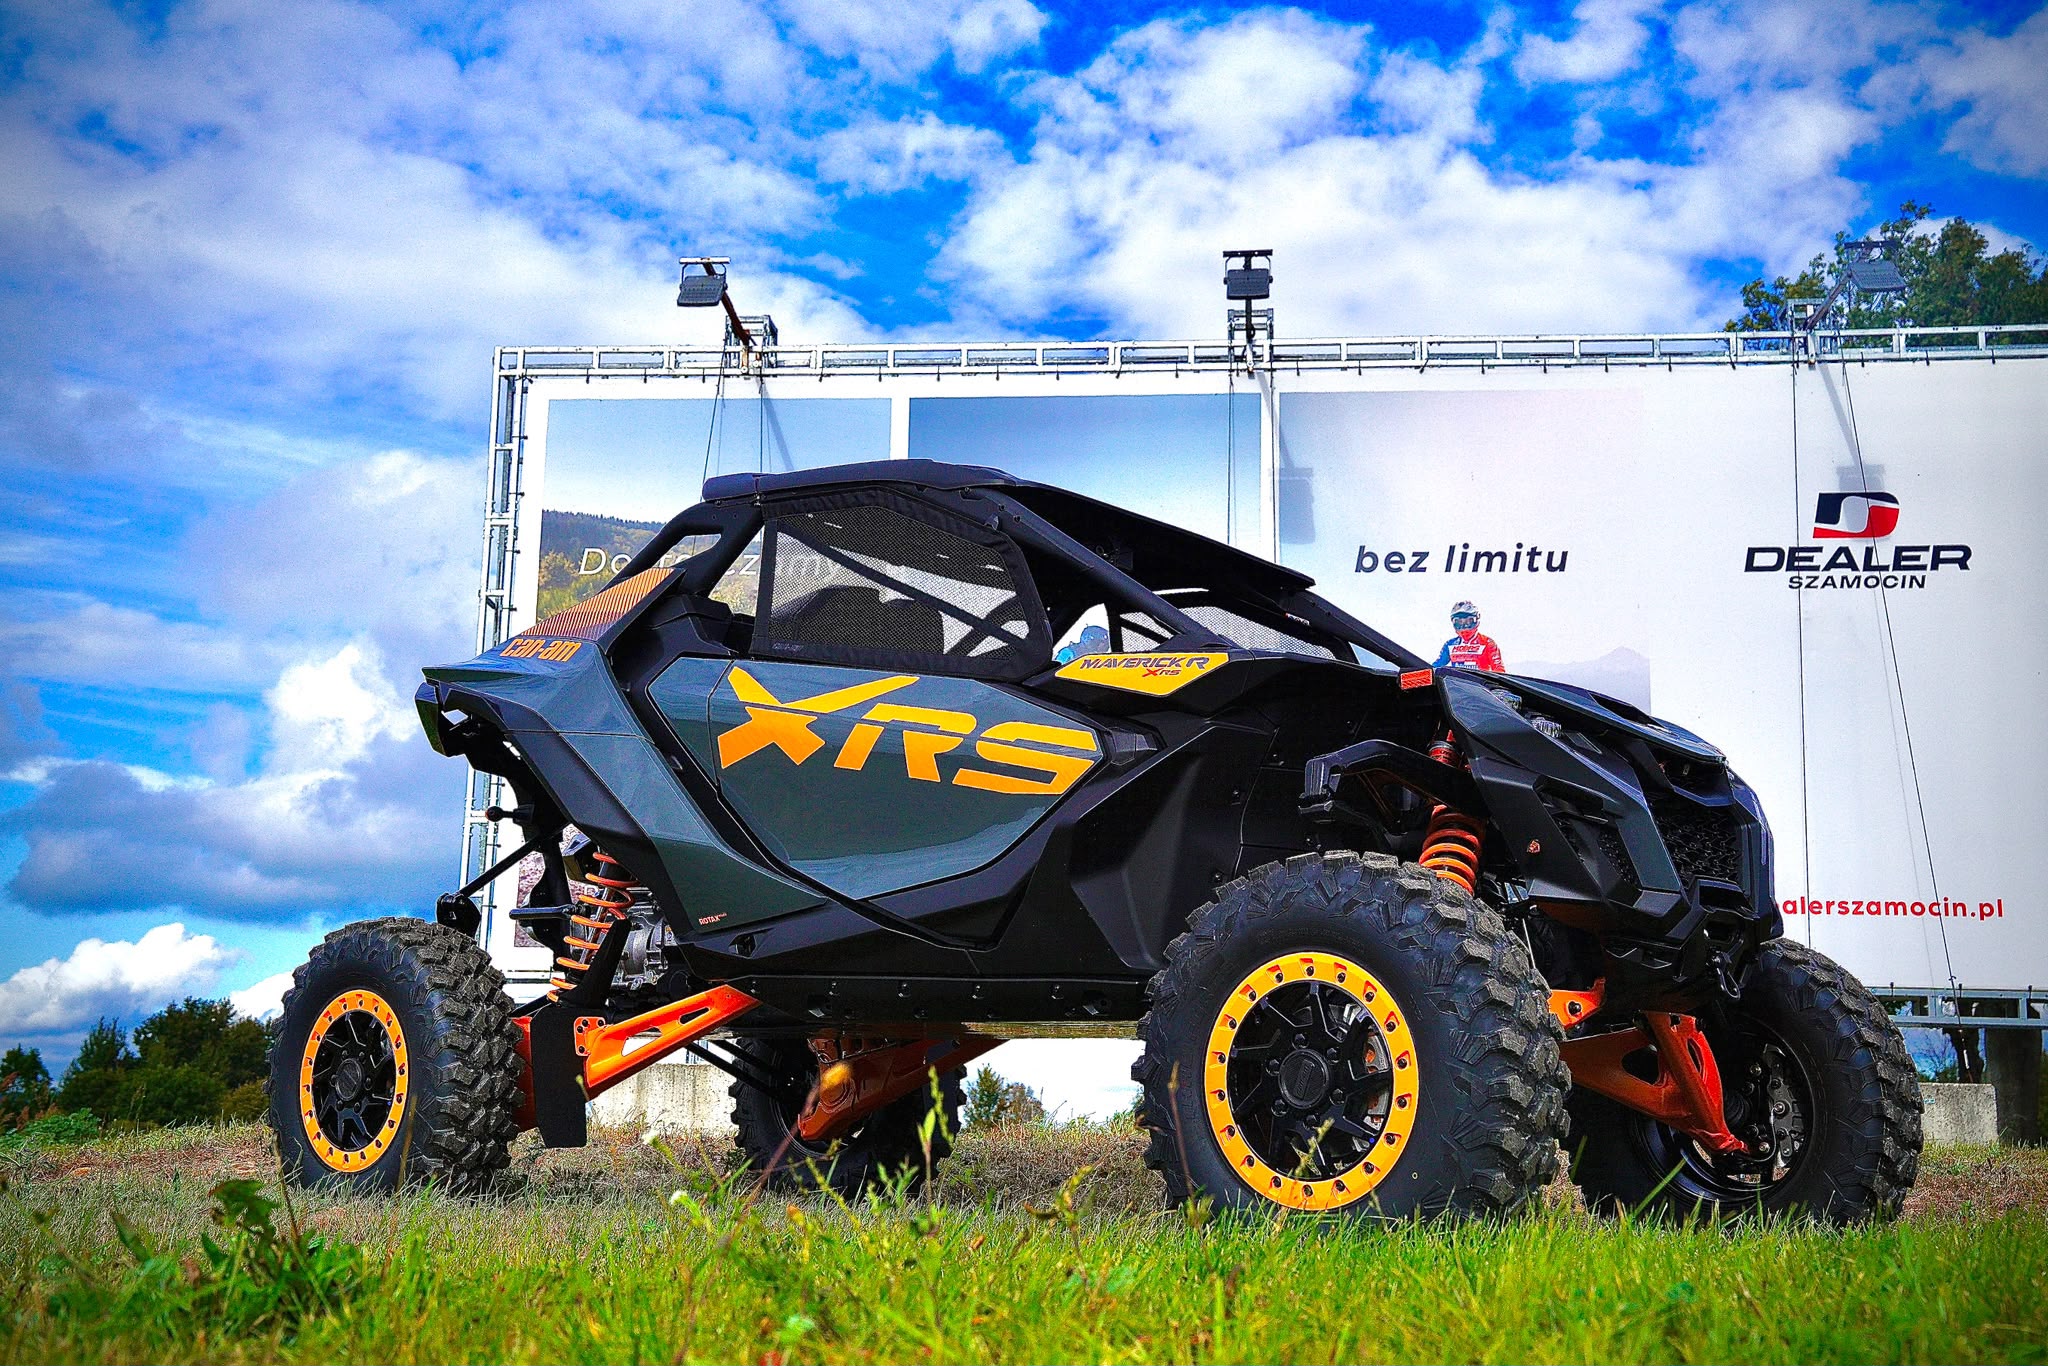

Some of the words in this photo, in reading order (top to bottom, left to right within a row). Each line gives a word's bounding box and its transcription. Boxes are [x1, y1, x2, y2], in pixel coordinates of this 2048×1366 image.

[1354, 544, 1430, 573] bez
[1444, 542, 1569, 573] limitu
[1744, 544, 1973, 573] DEALER
[1788, 574, 1927, 590] SZAMOCIN
[1079, 657, 1186, 669] MAVERICK
[1184, 657, 1210, 669] R
[1142, 668, 1181, 677] XRS
[717, 666, 1100, 795] XRS
[1776, 896, 2004, 921] alerszamocin.pl
